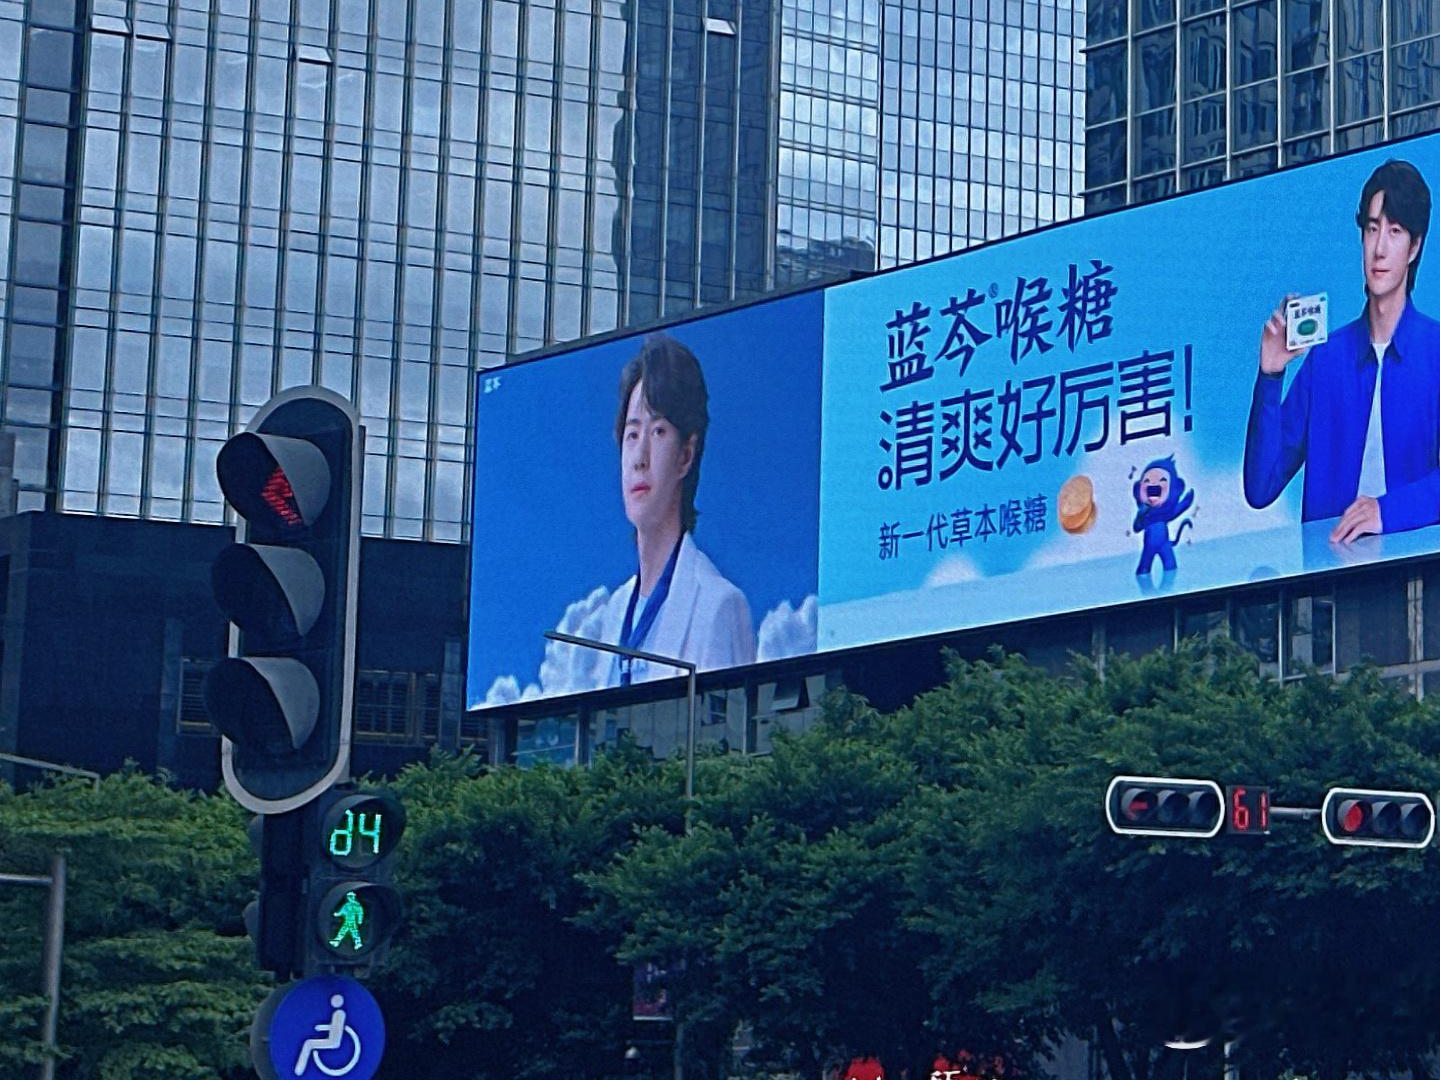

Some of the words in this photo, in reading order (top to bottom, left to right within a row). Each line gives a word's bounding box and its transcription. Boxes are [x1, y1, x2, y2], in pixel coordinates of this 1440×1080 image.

[879, 259, 1120, 393] 蓝芩喉糖
[878, 494, 1049, 562] 新一代草本喉糖
[1233, 788, 1268, 831] 61
